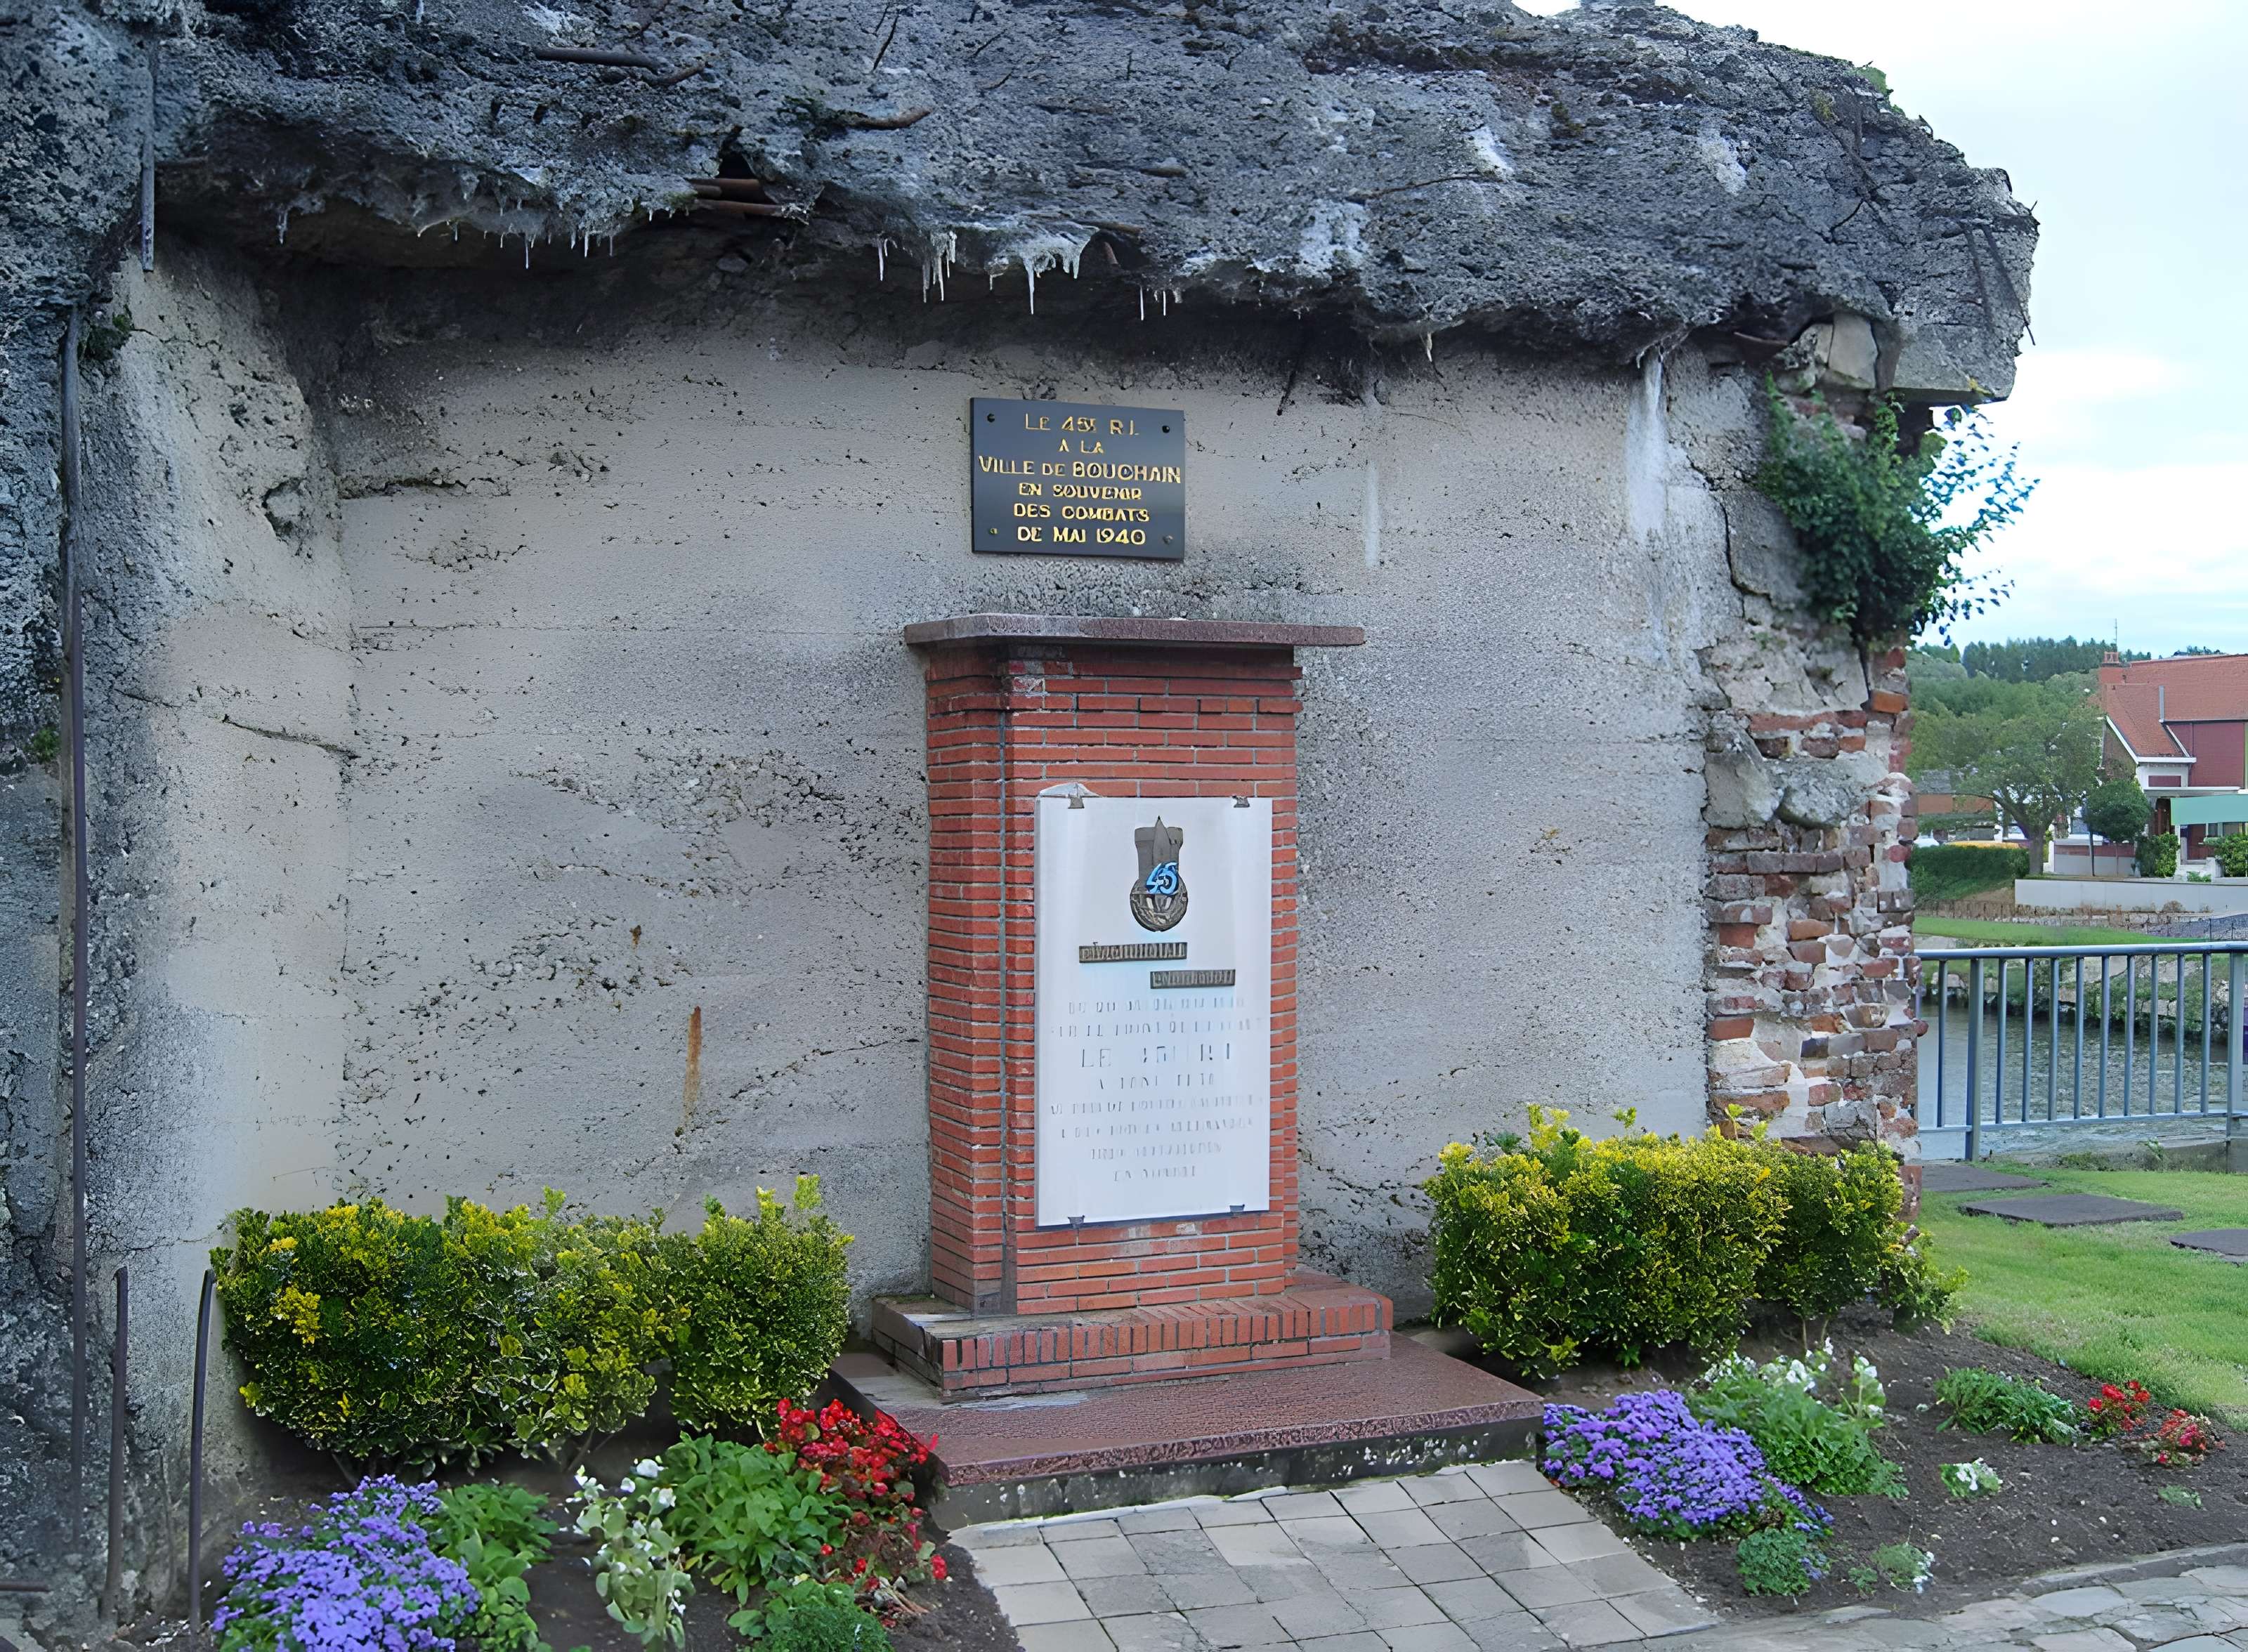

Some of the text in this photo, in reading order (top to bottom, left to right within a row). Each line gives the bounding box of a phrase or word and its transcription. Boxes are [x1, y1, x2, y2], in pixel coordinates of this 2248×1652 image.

[1025, 413, 1051, 431] LE
[1080, 440, 1104, 454] LA
[979, 455, 1181, 483] VILLE DE BOUCHAIN
[1019, 483, 1142, 500] EN SOUVENIR
[1014, 503, 1149, 522] DES COMBATS
[1017, 526, 1146, 545] DE MAI 1940
